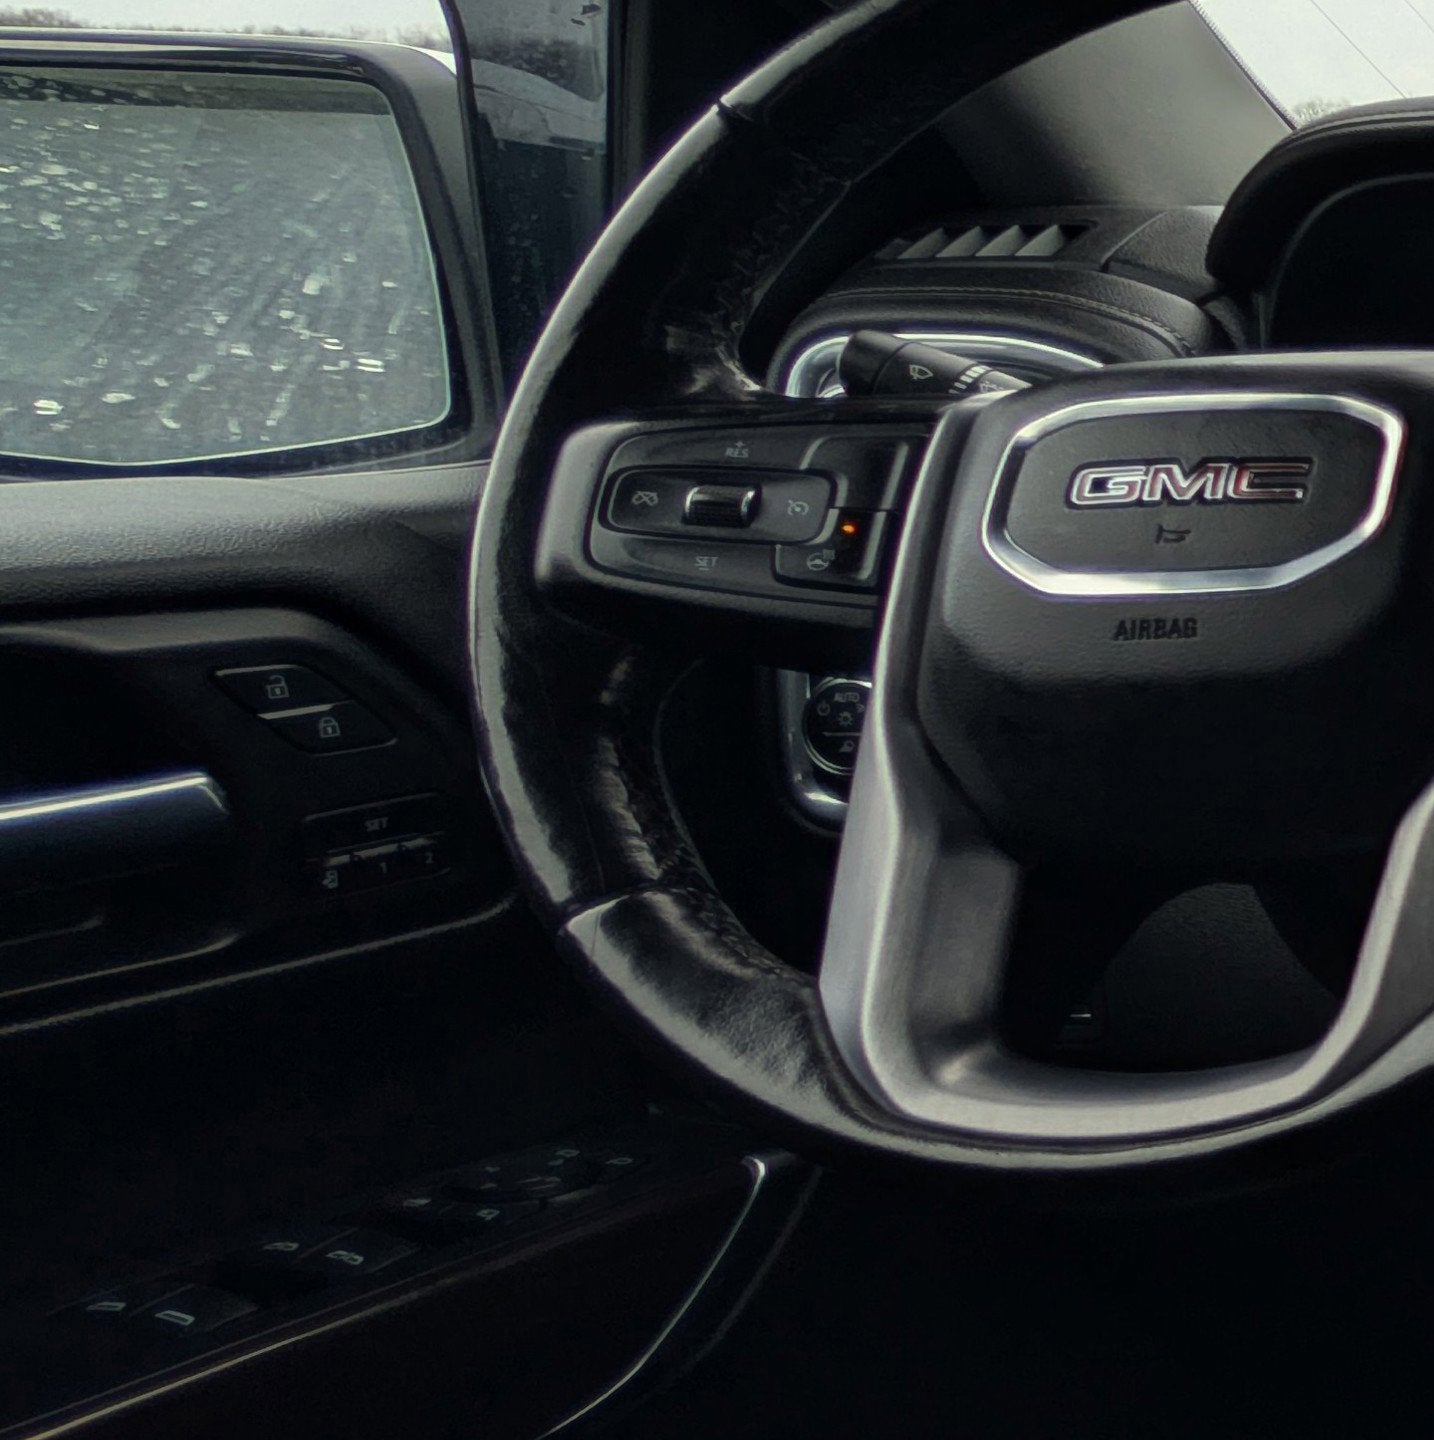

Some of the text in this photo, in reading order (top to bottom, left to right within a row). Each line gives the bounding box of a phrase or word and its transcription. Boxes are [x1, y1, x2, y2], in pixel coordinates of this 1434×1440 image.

[725, 446, 750, 459] RES
[1066, 457, 1313, 509] GMC
[694, 555, 718, 568] SET
[1113, 617, 1199, 641] AIRBAG
[833, 692, 861, 703] AUTO
